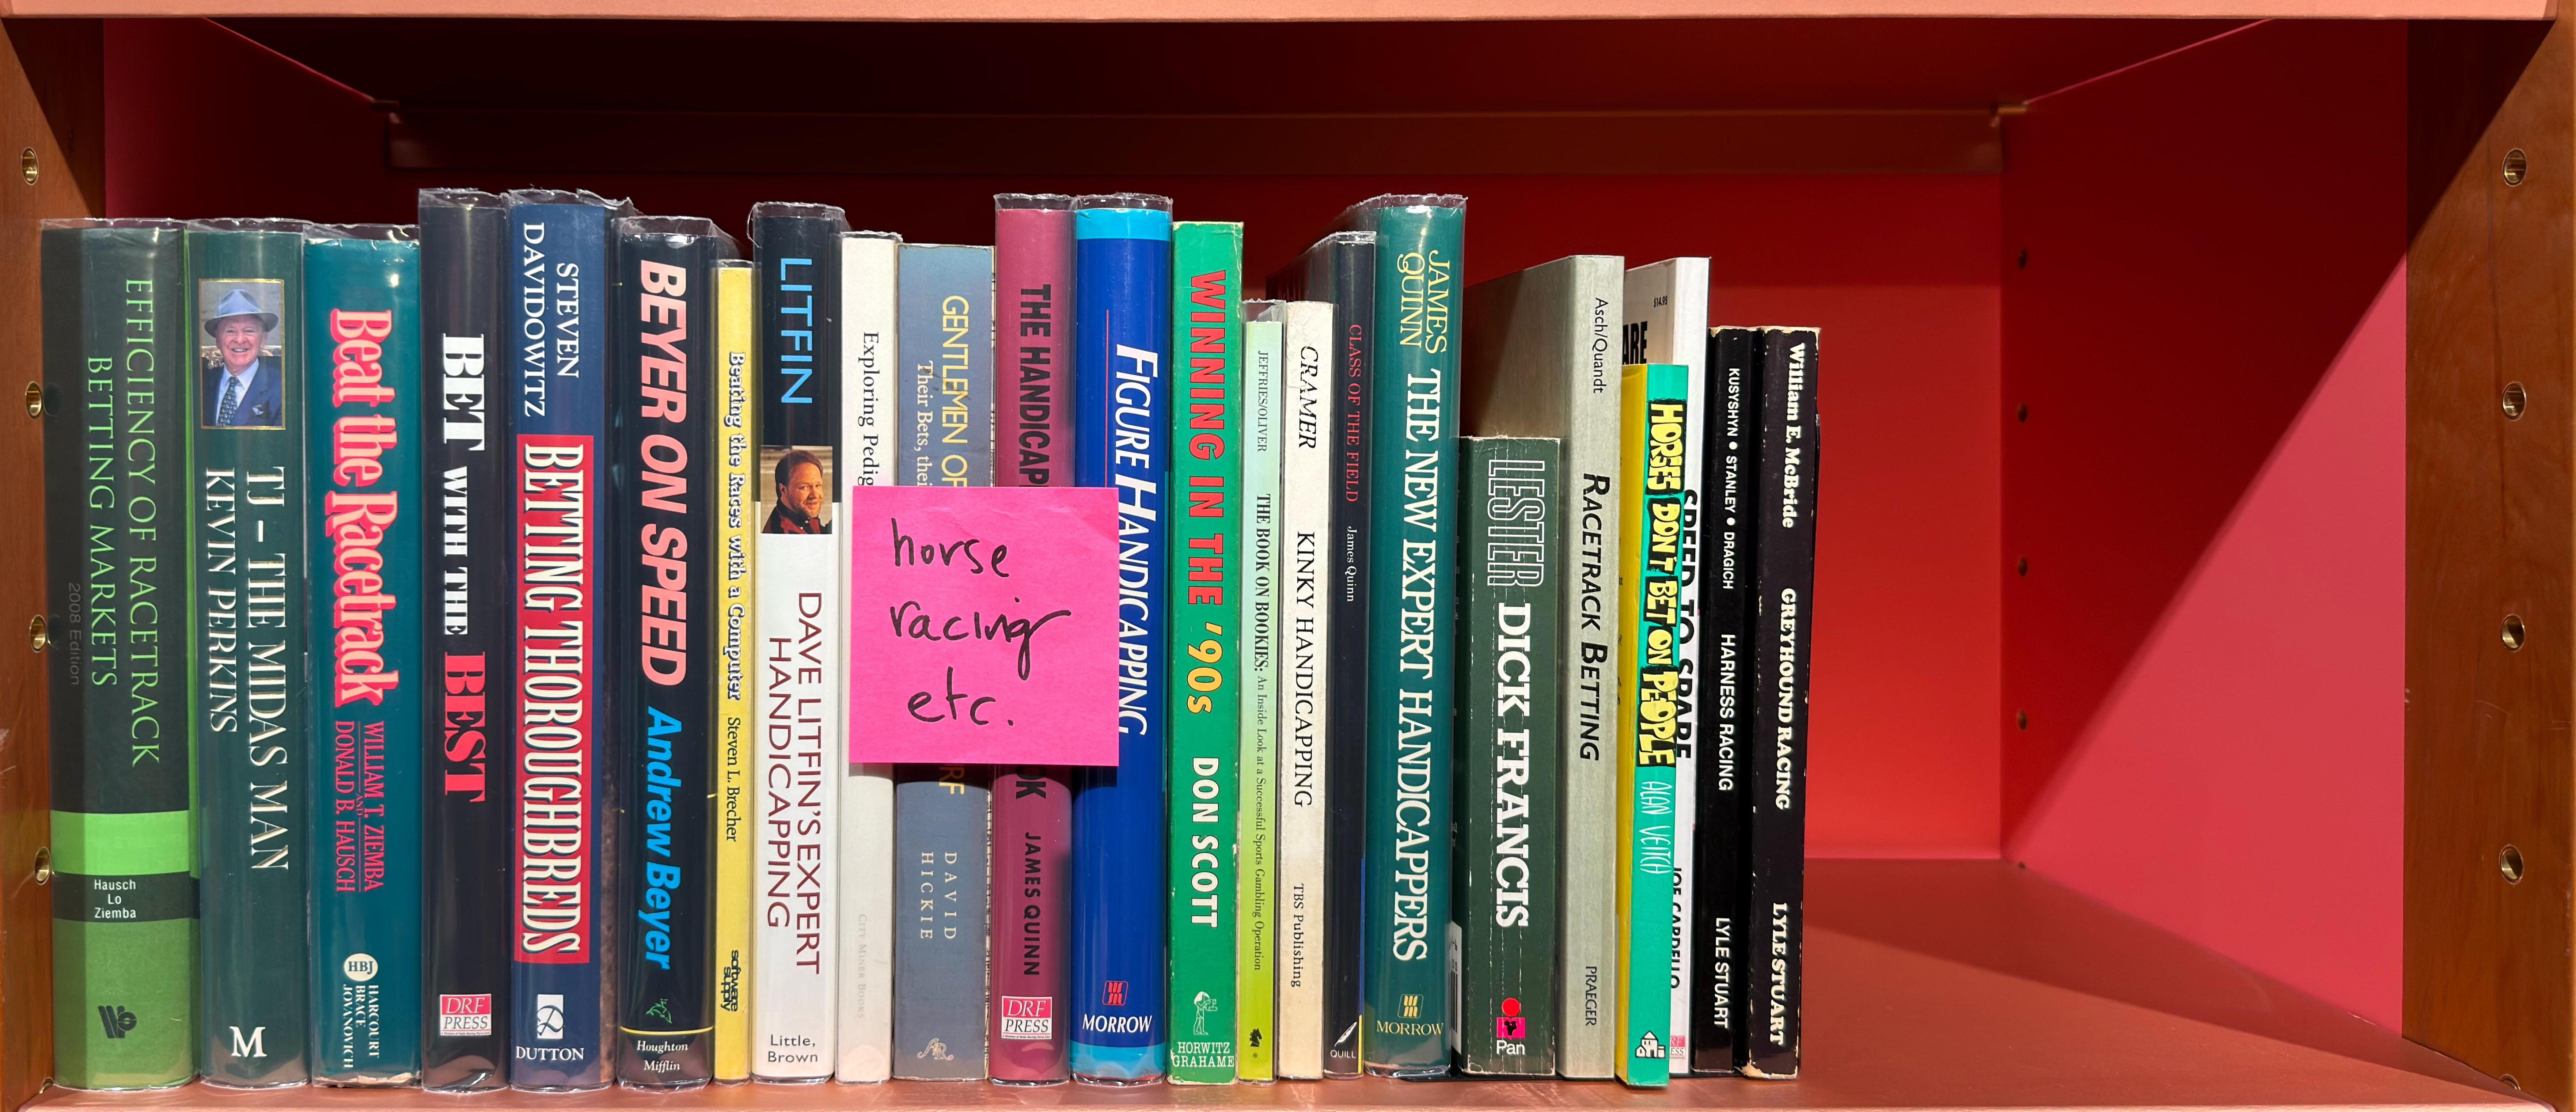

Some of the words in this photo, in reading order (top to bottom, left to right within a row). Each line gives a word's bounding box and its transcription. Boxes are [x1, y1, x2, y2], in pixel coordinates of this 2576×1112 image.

[524, 223, 545, 417] DAVIDOWITZ
[557, 262, 579, 379] STEVEN
[781, 258, 812, 404] LITFIN
[1020, 284, 1051, 337] THE
[1397, 252, 1426, 348] QUINN
[1425, 250, 1450, 354] JAMES
[330, 308, 395, 407] Beat
[641, 259, 687, 424] BEYER
[942, 295, 969, 444] GENTLEMEN
[1189, 270, 1226, 460] WINNING
[1348, 324, 1362, 377] CLASS
[1591, 297, 1609, 394] Asch/Quandt
[126, 279, 156, 485] EFFICIENCY
[443, 333, 485, 451] BET
[724, 351, 746, 428] Beating
[858, 331, 880, 427] Exploring
[917, 360, 933, 407] Their
[1115, 344, 1158, 469] FIGURE
[1257, 350, 1269, 452] JEFFRIES/OLIVER
[1298, 346, 1319, 449] CRAMER
[1347, 384, 1362, 406] OF
[1406, 368, 1441, 442] THE
[1727, 368, 1740, 437] KUSYSHYN
[1786, 342, 1805, 422] William
[88, 357, 115, 510] BETTING
[333, 414, 398, 486] the
[728, 433, 747, 468] the
[914, 411, 933, 451] Bets,
[1346, 411, 1361, 445] THE
[1647, 403, 1684, 491] HORSES
[1785, 426, 1802, 443] E.
[247, 466, 285, 506] TJ
[641, 434, 688, 514] ON
[728, 472, 746, 529] Races
[1188, 476, 1224, 517] IN
[1345, 451, 1359, 502] FIELD
[1404, 450, 1438, 533] NEW
[1725, 455, 1737, 513] STANLEY
[1782, 447, 1801, 528] McBride
[129, 497, 156, 541] OF
[206, 467, 236, 576] KEVIN
[443, 465, 468, 557] WITH
[523, 443, 584, 614] BETTING
[1256, 493, 1271, 524] THE
[1487, 459, 1545, 587] LESTER
[728, 535, 747, 581] with
[891, 517, 1010, 577] horse
[1188, 533, 1224, 605] THE
[1255, 528, 1270, 572] BOOK
[1296, 531, 1315, 608] KINKY
[1346, 526, 1357, 563] James
[1582, 473, 1611, 631] RACETRACK
[1723, 531, 1735, 589] DRAGICH
[68, 583, 81, 623] 2008
[90, 525, 117, 686] MARKETS
[247, 553, 286, 628] THE
[325, 491, 399, 708] Racetrack
[444, 566, 468, 635] THE
[641, 523, 688, 686] SPEED
[728, 585, 742, 599] a
[1115, 473, 1157, 736] HANDICAPPING
[1255, 576, 1270, 597] ON
[1344, 566, 1357, 602] Quinn
[1399, 539, 1436, 679] EXPERT
[1646, 580, 1678, 626] BET
[69, 631, 81, 685] Edition
[129, 557, 159, 767] RACETRACK
[208, 587, 238, 733] PERKINS
[723, 602, 746, 701] Computer
[798, 592, 822, 684] DAVE
[890, 597, 1072, 681] racing
[1254, 601, 1270, 672] BOOKIES:
[1497, 602, 1531, 717] DICK
[1647, 628, 1674, 665] ON
[1778, 588, 1798, 724] GREYHOUND
[248, 640, 288, 767] MIDAS
[908, 666, 1014, 726] etc.
[1257, 675, 1267, 690] An
[1257, 694, 1267, 725] Inside
[1579, 642, 1608, 761] BETTING
[1720, 633, 1736, 720] HARNESS
[445, 652, 486, 802] BEST
[727, 717, 741, 766] Steven
[1257, 728, 1267, 752] Look
[1294, 617, 1314, 808] HANDICAPPING
[1639, 671, 1678, 766] PEOPLE
[335, 721, 355, 793] DONALD
[364, 721, 384, 798] WILLIAM
[521, 620, 583, 954] THOROUGHBREDS
[646, 706, 682, 858] Andrew
[727, 770, 741, 783] L.
[767, 637, 792, 928] HANDICAPPING
[1192, 757, 1219, 823] DON
[1257, 756, 1264, 765] at
[1718, 723, 1734, 791] RACING
[1776, 727, 1793, 811] RACING
[250, 781, 288, 870] MAN
[335, 799, 355, 813] B.
[364, 805, 384, 819] T.
[726, 786, 742, 843] Brecher
[1256, 777, 1266, 831] Successful
[1393, 688, 1433, 961] HANDICAPPERS
[1496, 729, 1530, 928] FRANCIS
[1640, 781, 1673, 815] ALAN
[335, 821, 355, 892] HAUSCH
[364, 825, 384, 892] ZIEMBA
[1025, 832, 1042, 898] JAMES
[1191, 835, 1218, 928] SCOTT
[1253, 834, 1265, 865] Sports
[1639, 825, 1672, 874] VEITCH
[94, 879, 136, 891] Hausch
[94, 907, 136, 919] Ziemba
[107, 894, 122, 905] Lo
[638, 861, 681, 970] Beyer
[796, 843, 821, 975] EXPERT
[921, 851, 934, 939] HICKIE
[944, 851, 957, 940] DAVID
[1252, 868, 1265, 918] Gambling
[1293, 883, 1304, 909] TBS
[1024, 904, 1041, 976] QUINN
[1252, 921, 1264, 971] Operation
[1291, 915, 1304, 987] Publishing
[1715, 918, 1731, 958] LYLE
[1772, 902, 1788, 956] LYLE
[348, 961, 374, 975] HBJ
[721, 966, 732, 1012] supply
[731, 949, 742, 1012] software
[1585, 965, 1597, 1026] PRAEGER
[1714, 962, 1729, 1029] STUART
[1769, 959, 1785, 1045] STUART
[343, 984, 354, 1068] JOVANOVICH
[355, 985, 366, 1027] BRACE
[368, 984, 380, 1059] HARCOURT
[444, 1016, 488, 1029] PRESS
[446, 997, 486, 1014] DRF
[1005, 1019, 1048, 1032] PRESS
[1007, 999, 1047, 1017] DRF
[1082, 1014, 1153, 1033] MORROW
[1376, 1021, 1444, 1035] MORROW
[229, 1025, 267, 1058] M
[516, 1046, 585, 1061] DUTTON
[637, 1040, 688, 1053] Houghton
[644, 1060, 680, 1071] Mifflin
[767, 1051, 818, 1063] Brown
[770, 1035, 816, 1048] Little,
[1172, 1055, 1234, 1067] GRAHAME
[1177, 1041, 1230, 1054] HORWITZ
[1330, 1050, 1357, 1059] QUILL
[1496, 1040, 1525, 1055] Pan
